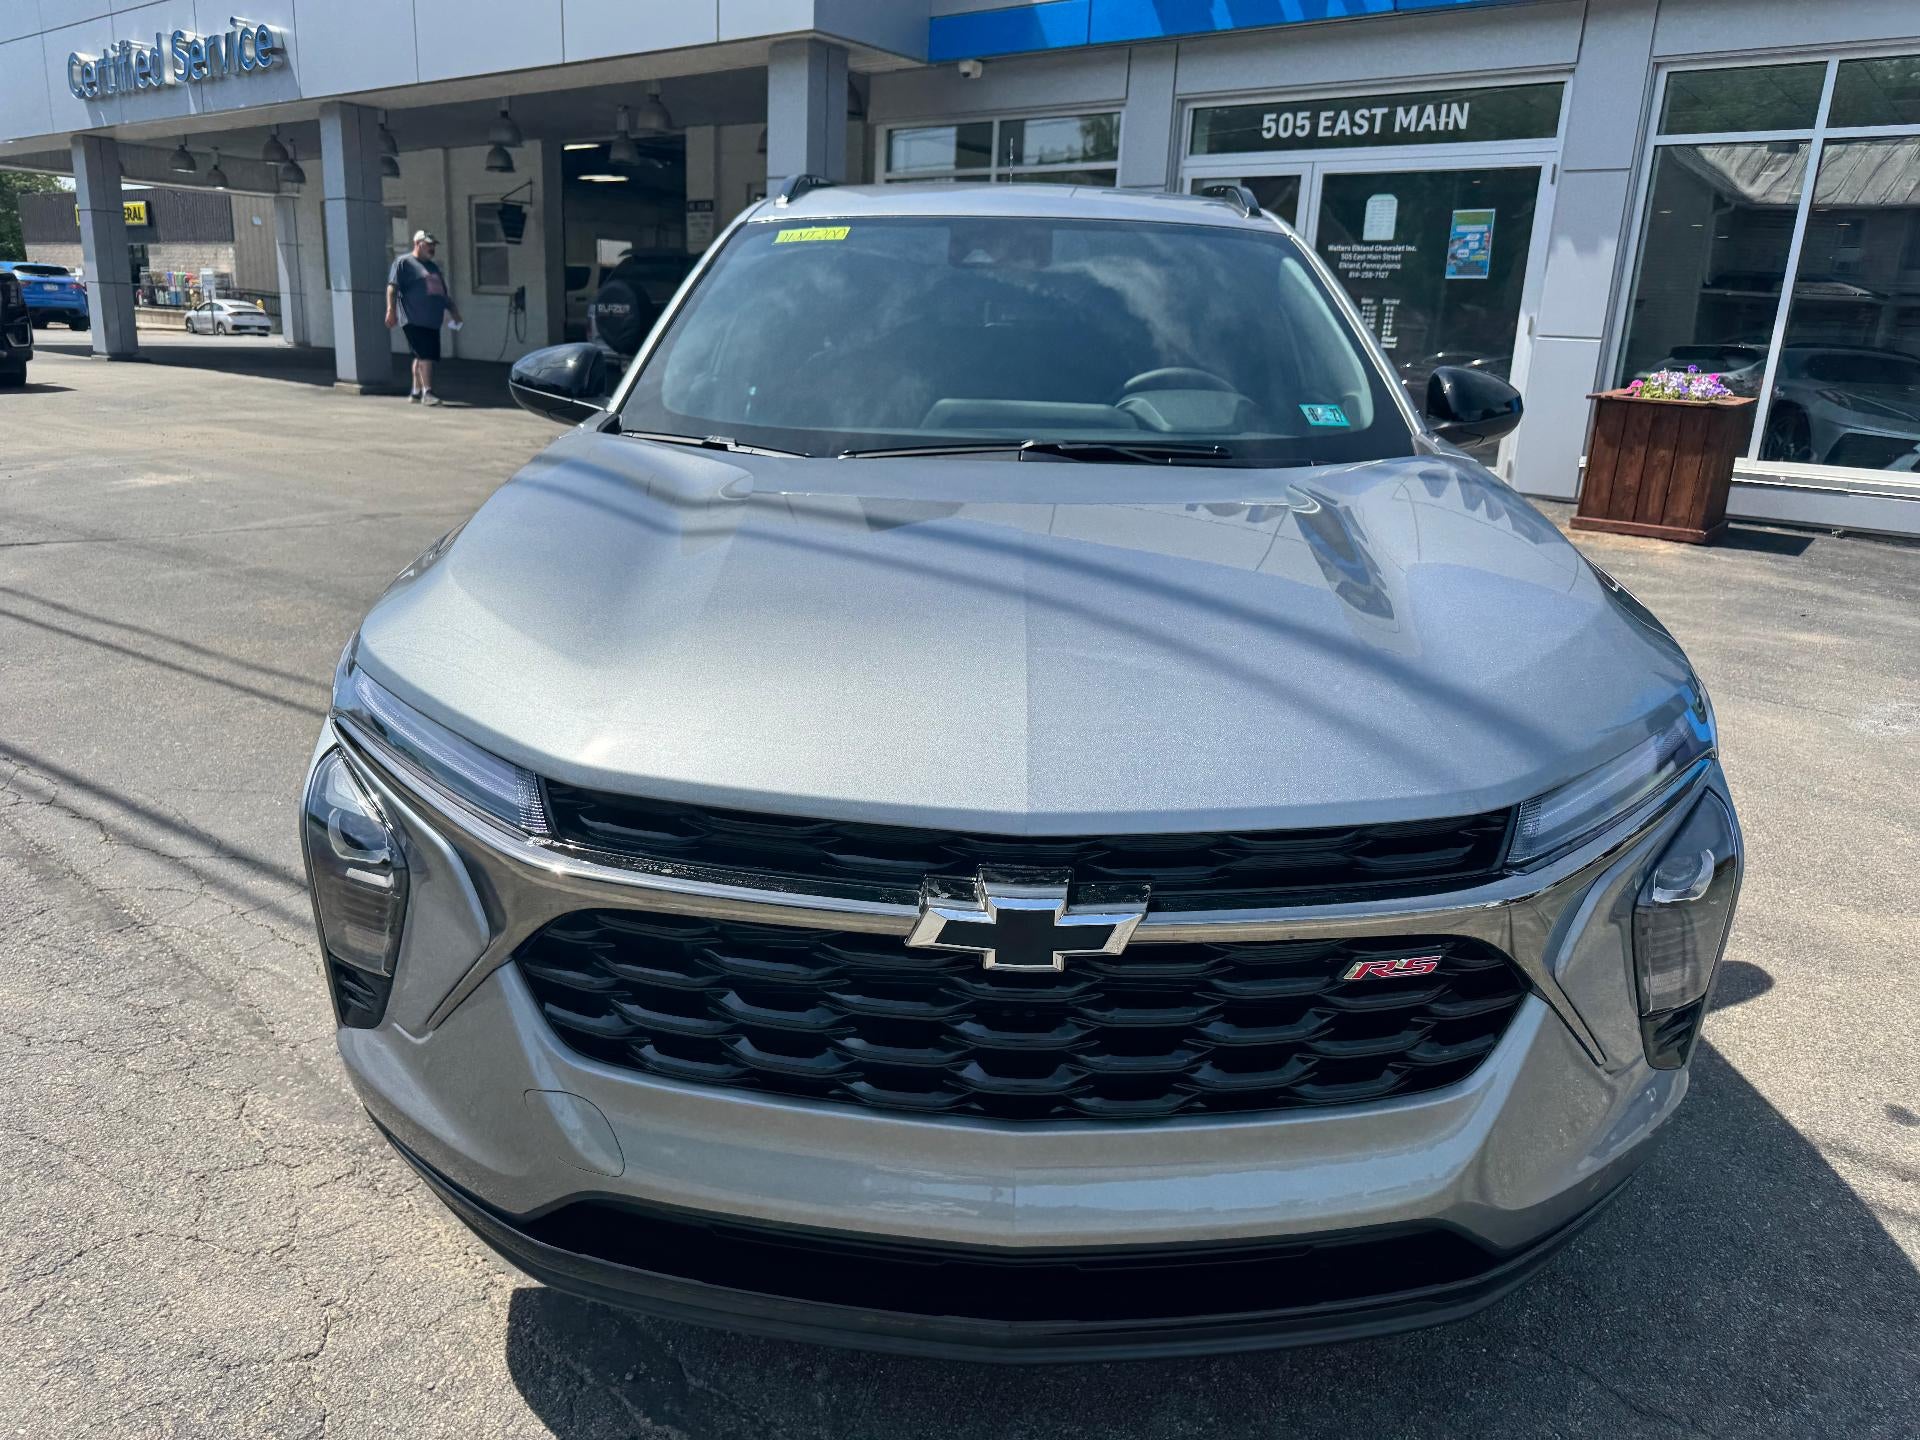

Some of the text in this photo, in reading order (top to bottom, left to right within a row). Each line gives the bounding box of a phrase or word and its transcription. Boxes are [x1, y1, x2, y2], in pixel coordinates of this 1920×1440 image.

[68, 16, 276, 99] Certified Service
[1261, 102, 1470, 139] 505 EAST MAIN
[1375, 244, 1405, 252] Chevrolet
[1343, 955, 1442, 980] RS
